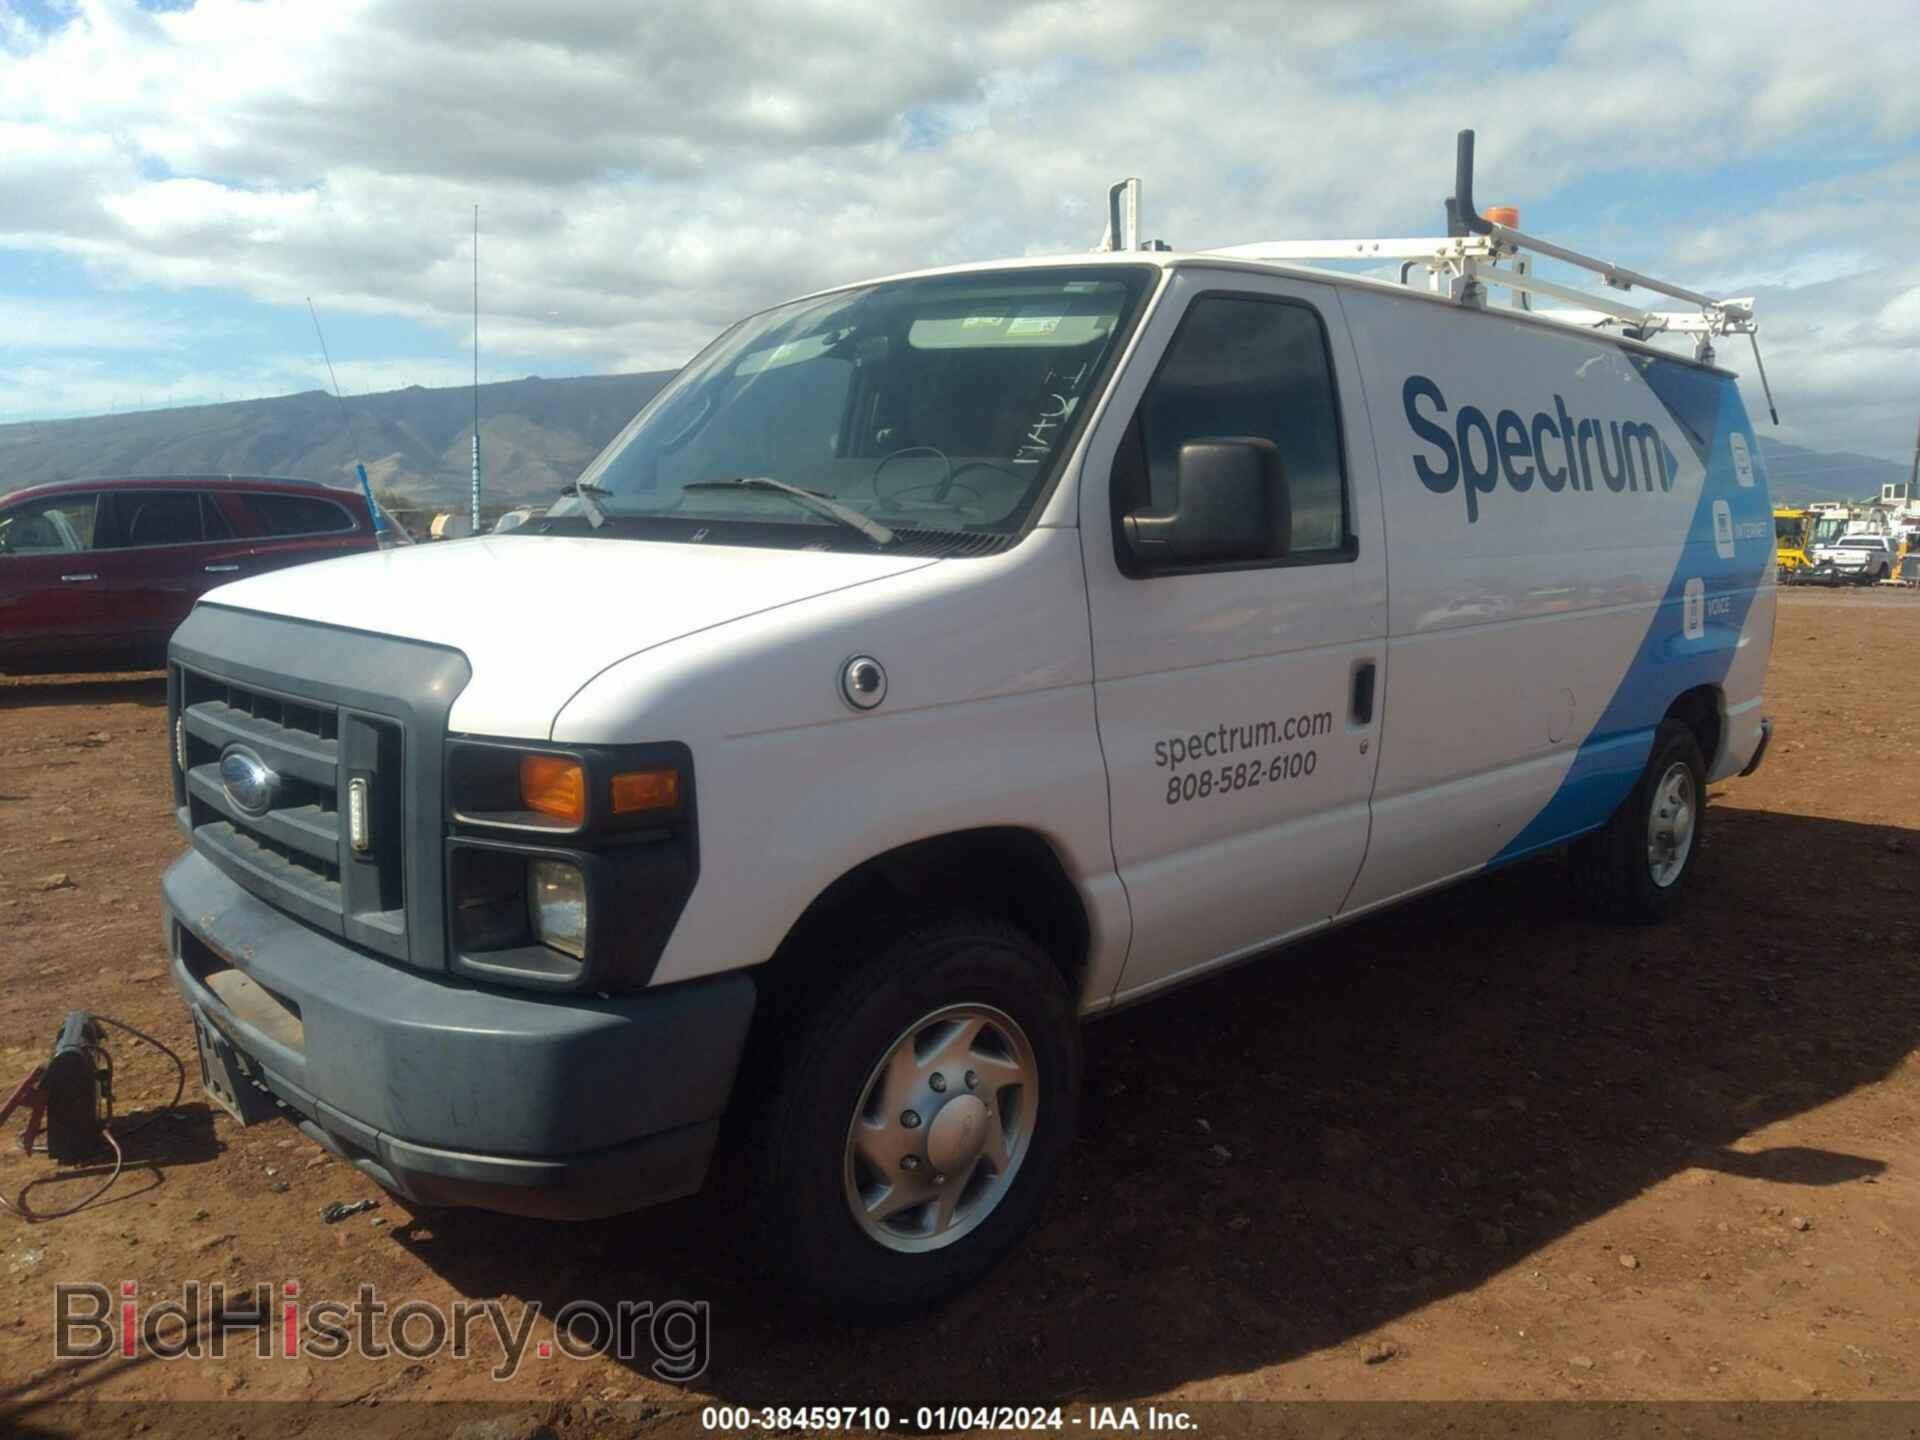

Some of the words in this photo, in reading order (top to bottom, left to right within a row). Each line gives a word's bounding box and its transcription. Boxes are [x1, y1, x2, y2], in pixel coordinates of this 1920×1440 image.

[1402, 375, 1670, 524] Spectrum
[1154, 711, 1333, 771] spectrum.com
[1166, 750, 1317, 805] 808-582-6100
